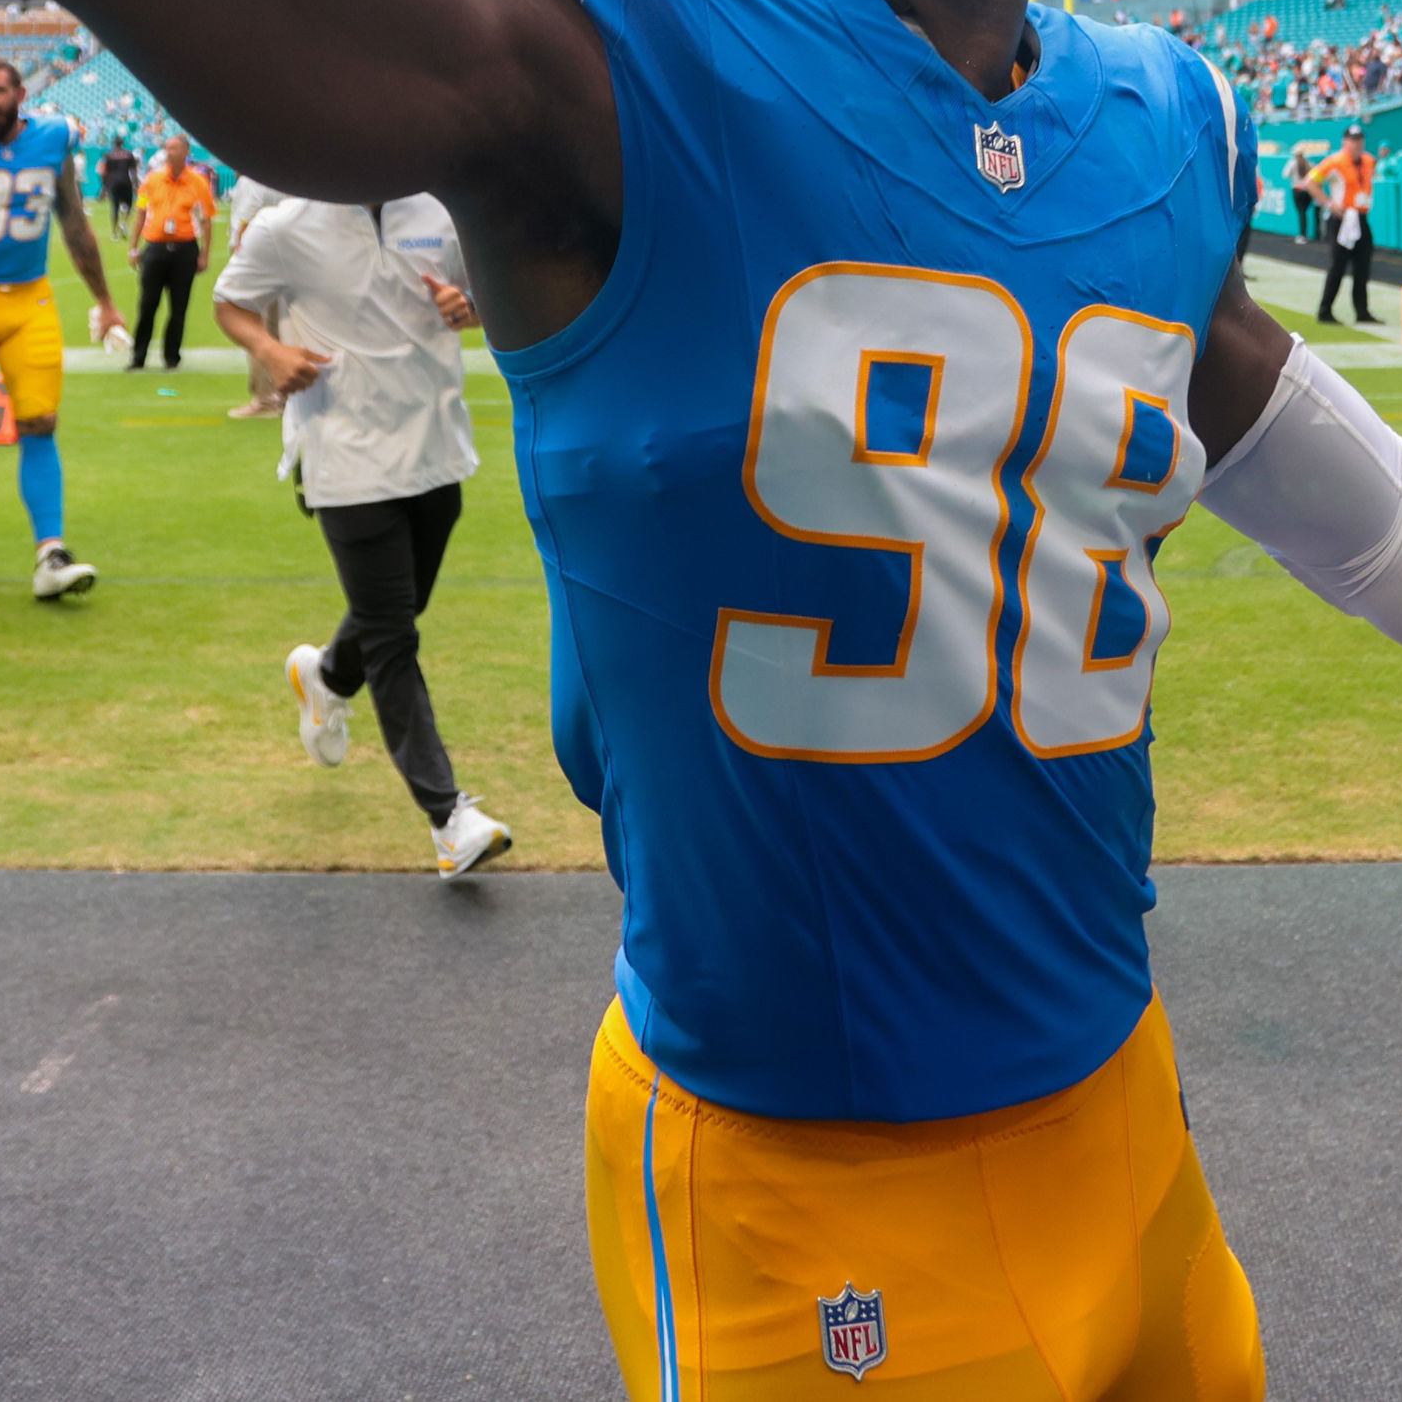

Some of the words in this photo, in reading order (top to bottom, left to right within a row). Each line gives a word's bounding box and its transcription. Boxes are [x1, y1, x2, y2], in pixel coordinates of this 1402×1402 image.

[986, 150, 1018, 179] NFL
[709, 260, 1208, 765] 98
[831, 1324, 878, 1362] NFL
